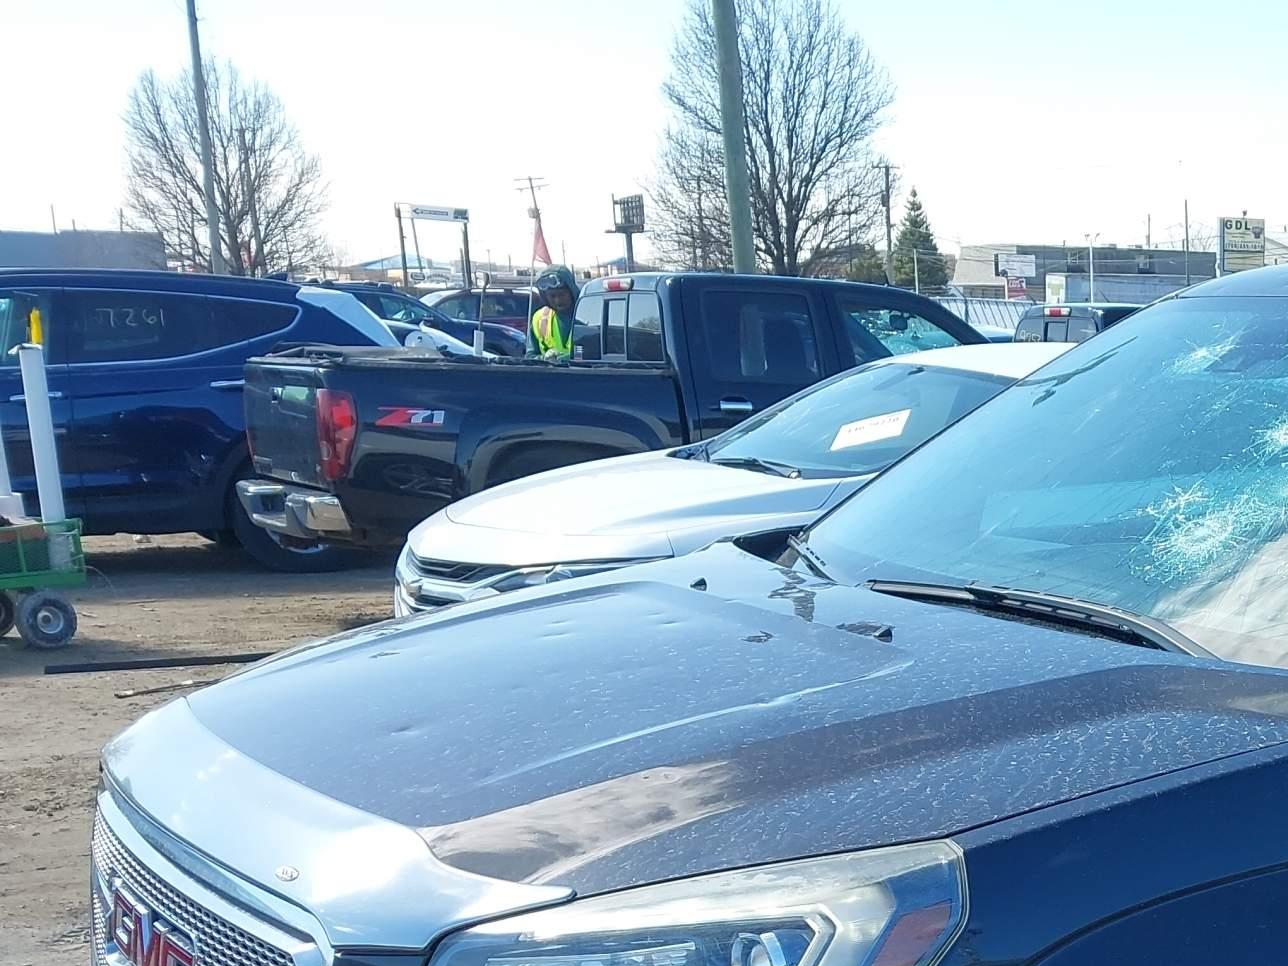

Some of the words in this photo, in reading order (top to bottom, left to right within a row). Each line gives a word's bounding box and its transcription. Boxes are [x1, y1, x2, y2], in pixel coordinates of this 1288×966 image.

[1225, 220, 1251, 231] GDL
[96, 308, 165, 327] 7261
[375, 406, 445, 426] Z71
